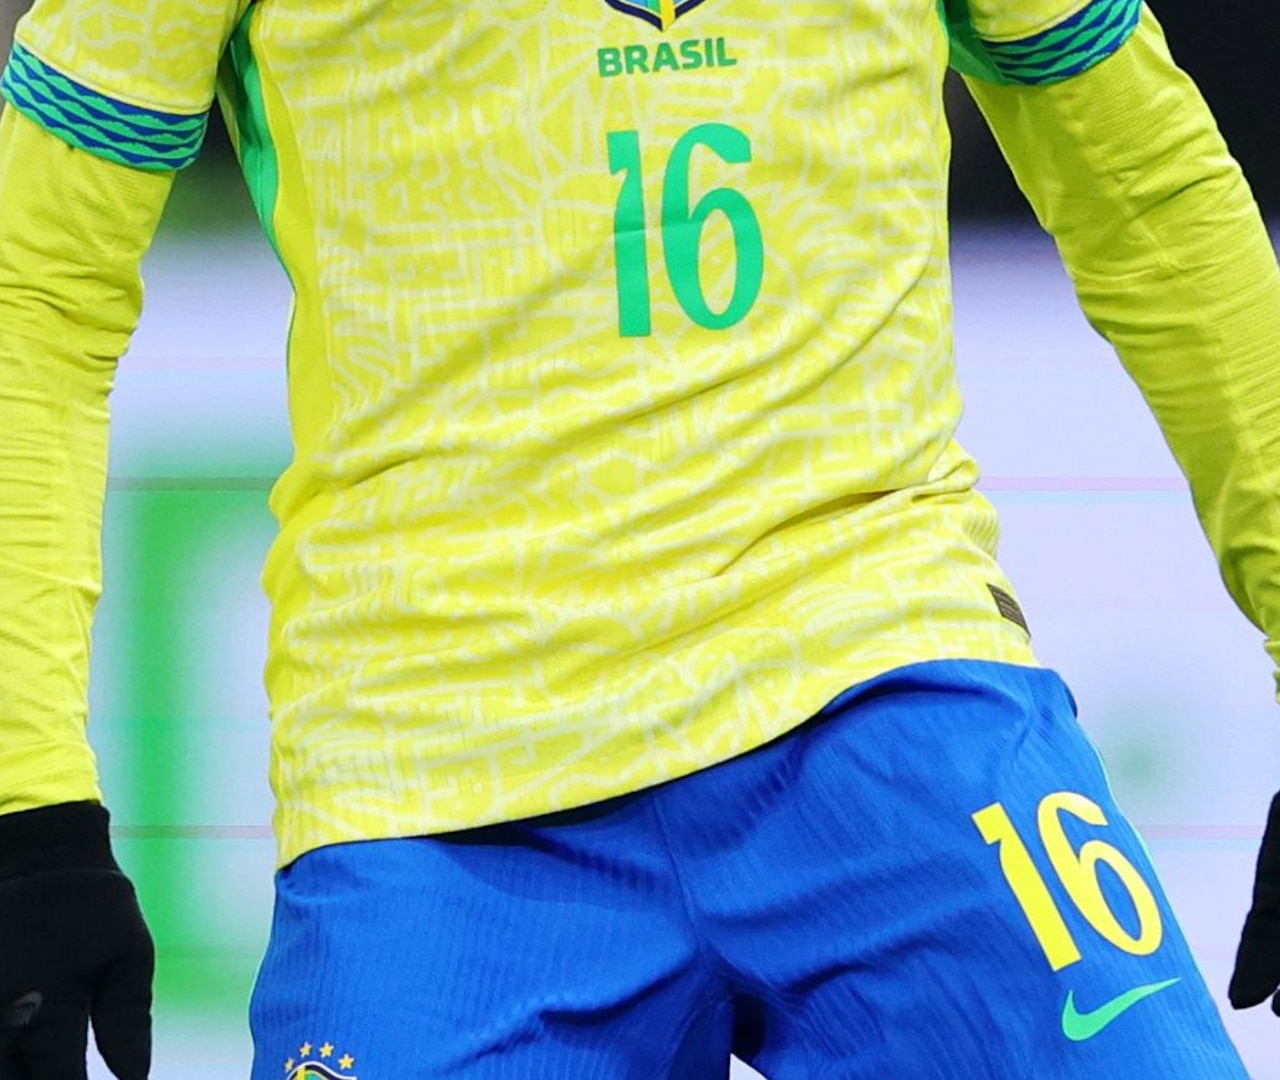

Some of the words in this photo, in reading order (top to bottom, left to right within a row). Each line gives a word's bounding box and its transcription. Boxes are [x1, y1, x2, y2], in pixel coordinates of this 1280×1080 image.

[597, 37, 738, 78] BRASIL
[607, 122, 765, 338] 16
[971, 791, 1163, 972] 16
